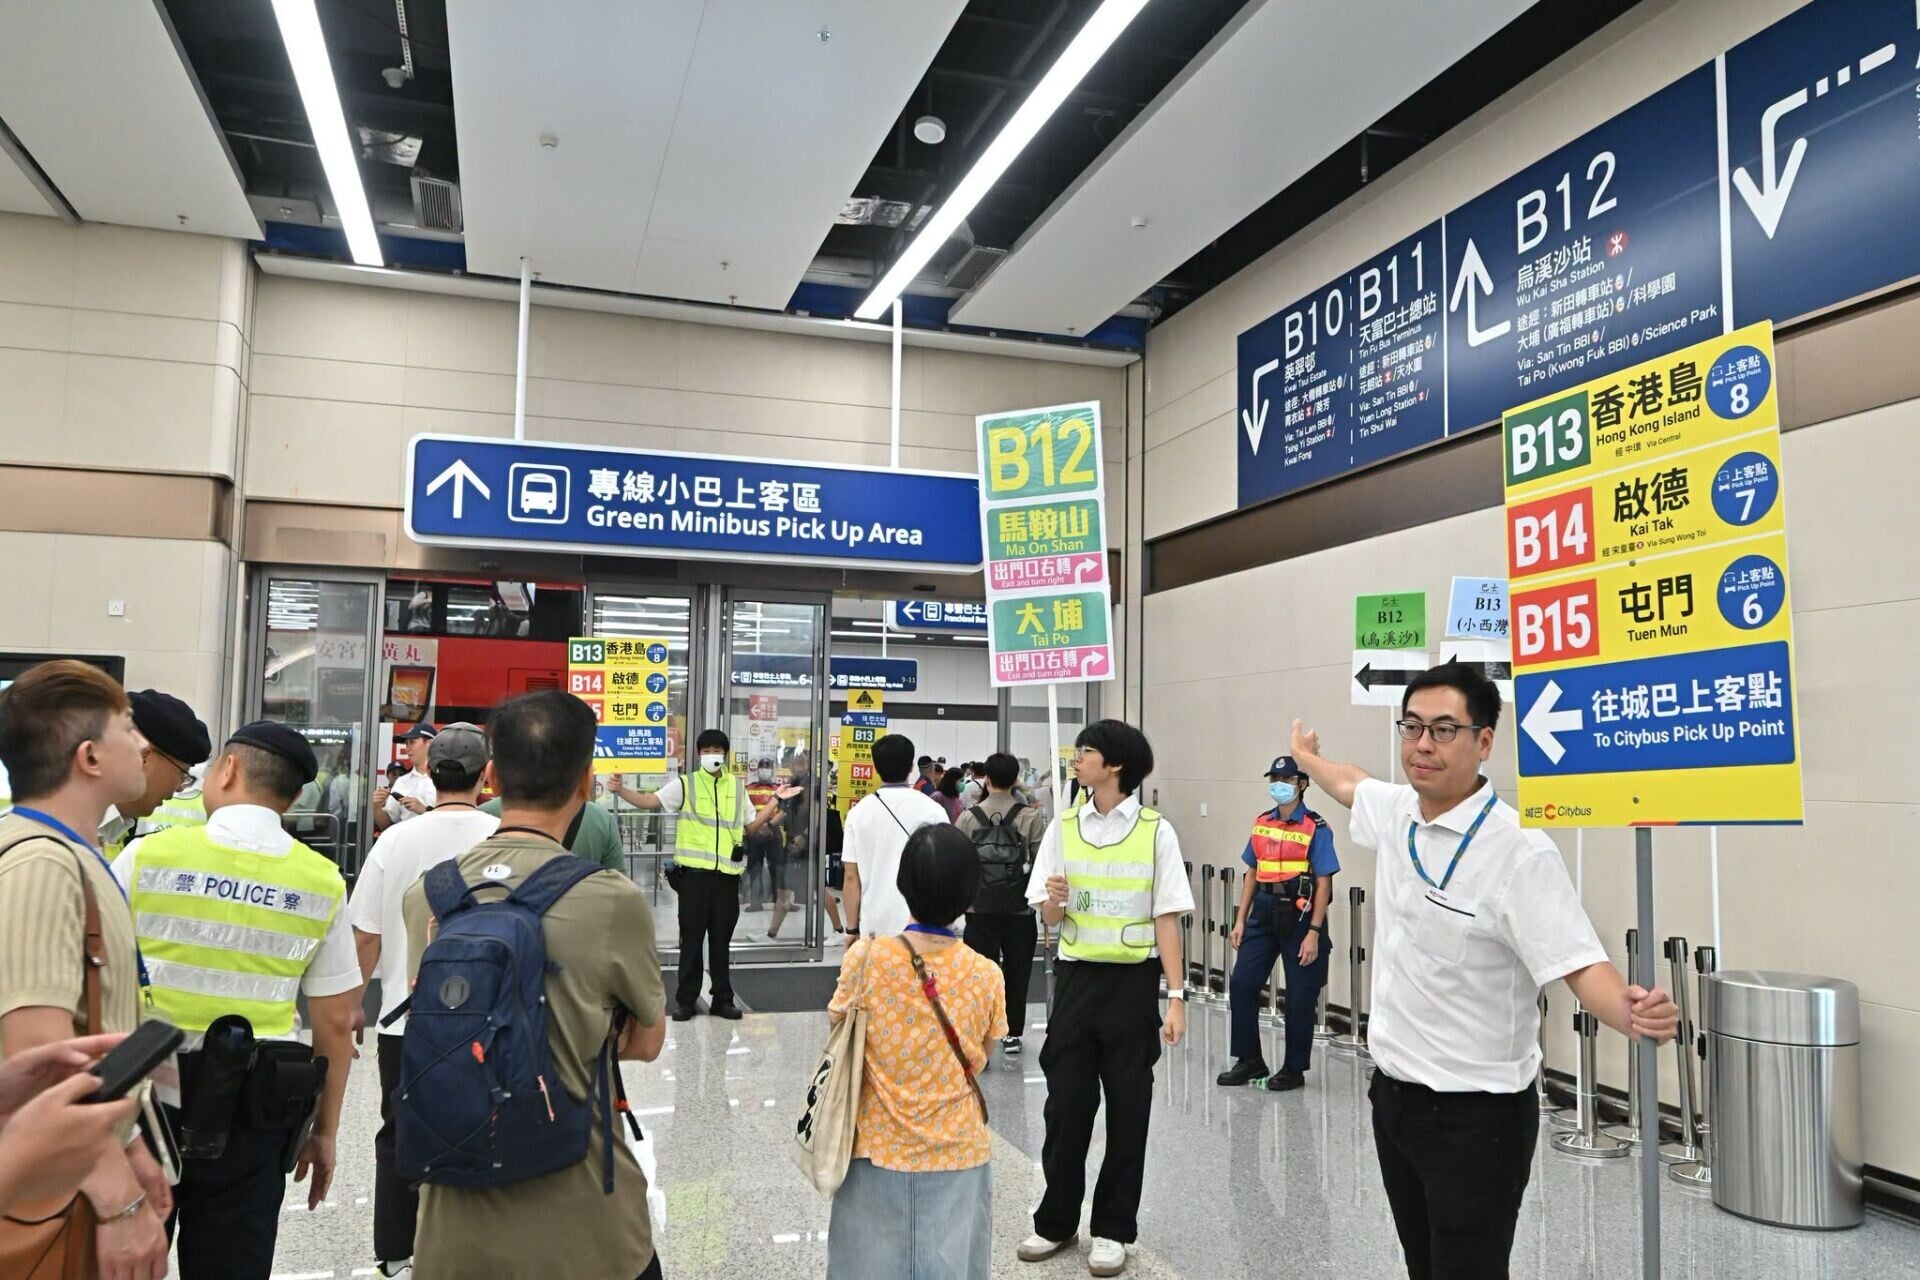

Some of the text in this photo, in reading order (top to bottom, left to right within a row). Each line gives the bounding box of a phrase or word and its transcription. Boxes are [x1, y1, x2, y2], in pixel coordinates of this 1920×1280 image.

[1517, 151, 1617, 254] B12
[1517, 235, 1592, 292] 烏溪沙站
[1360, 241, 1424, 321] B11
[1517, 260, 1605, 307] Wu Kai Sha Station
[1285, 288, 1344, 359] B10
[1359, 291, 1437, 347] 天富巴士總站
[1360, 324, 1421, 358] Tin Fu Bus Terminus
[1517, 332, 1591, 371] Via: San Tin BBI
[1518, 371, 1532, 387] Tai
[1533, 366, 1546, 382] Po
[1548, 352, 1584, 378] (Kwong
[1587, 344, 1605, 360] Fuk
[1608, 335, 1630, 354] BBI)
[1690, 304, 1717, 326] Park
[1310, 370, 1327, 384] Estate
[1724, 354, 1761, 377] 上客點
[1724, 368, 1762, 384] Pick Up Point
[1360, 401, 1370, 412] Via:
[1373, 396, 1384, 408] San
[1386, 391, 1395, 402] Tin
[1590, 361, 1703, 431] 香港島
[1730, 383, 1750, 414] 8
[1360, 397, 1417, 425] Yuen Long Station
[1360, 418, 1397, 438] Tin Shui Wai
[1596, 405, 1700, 448] Hong Kong Island
[1285, 441, 1298, 456] Tsing
[1306, 430, 1325, 446] Station
[1511, 408, 1583, 476] B13
[1646, 440, 1657, 449] Via
[1658, 432, 1681, 446] Central
[989, 418, 1094, 492] B12
[1299, 450, 1312, 464] Fong
[1731, 461, 1768, 483] 上客點
[1731, 474, 1769, 489] Pick Up Point
[587, 468, 822, 514] 專線小巴上客區
[1735, 489, 1756, 522] 7
[587, 505, 923, 547] Green Minibus Pick Up Area
[1000, 506, 1089, 543] 馬鞍山
[1514, 502, 1588, 568] B14
[1629, 517, 1674, 537] Kai Tak
[1006, 538, 1084, 556] Ma On Shan
[1646, 538, 1658, 548] Via
[1659, 535, 1675, 548] Sung
[1677, 532, 1695, 545] Wong
[994, 557, 1071, 581] 出門口右轉
[1737, 565, 1775, 584] 上客點
[1002, 574, 1065, 588] Exit and turn right
[1737, 579, 1776, 592] Pick Up Point
[1475, 597, 1501, 611] B13
[1618, 574, 1694, 624] 屯門
[1742, 593, 1763, 625] 6
[1016, 599, 1083, 634] 大埔
[1378, 610, 1403, 624] B12
[1518, 594, 1591, 656] B15
[1031, 632, 1070, 647] Tai Po
[1627, 623, 1688, 643] Tuen Mun
[573, 644, 602, 661] B13
[607, 642, 646, 656] 香港島
[653, 654, 661, 663] 8
[1000, 649, 1077, 672] 出門口右轉
[572, 675, 602, 692] B14
[1007, 668, 1071, 681] Exit and turn right
[653, 683, 660, 692] 7
[1591, 670, 1783, 724] 往城巴上客點
[612, 703, 638, 716] 屯門
[653, 712, 660, 721] 6
[855, 730, 873, 740] B13
[1593, 719, 1785, 749] To Citybus Pick Up Point
[853, 766, 871, 778] B14
[1525, 806, 1592, 818] 城巴 Citybus
[176, 873, 300, 910] 警 POLICE 察
